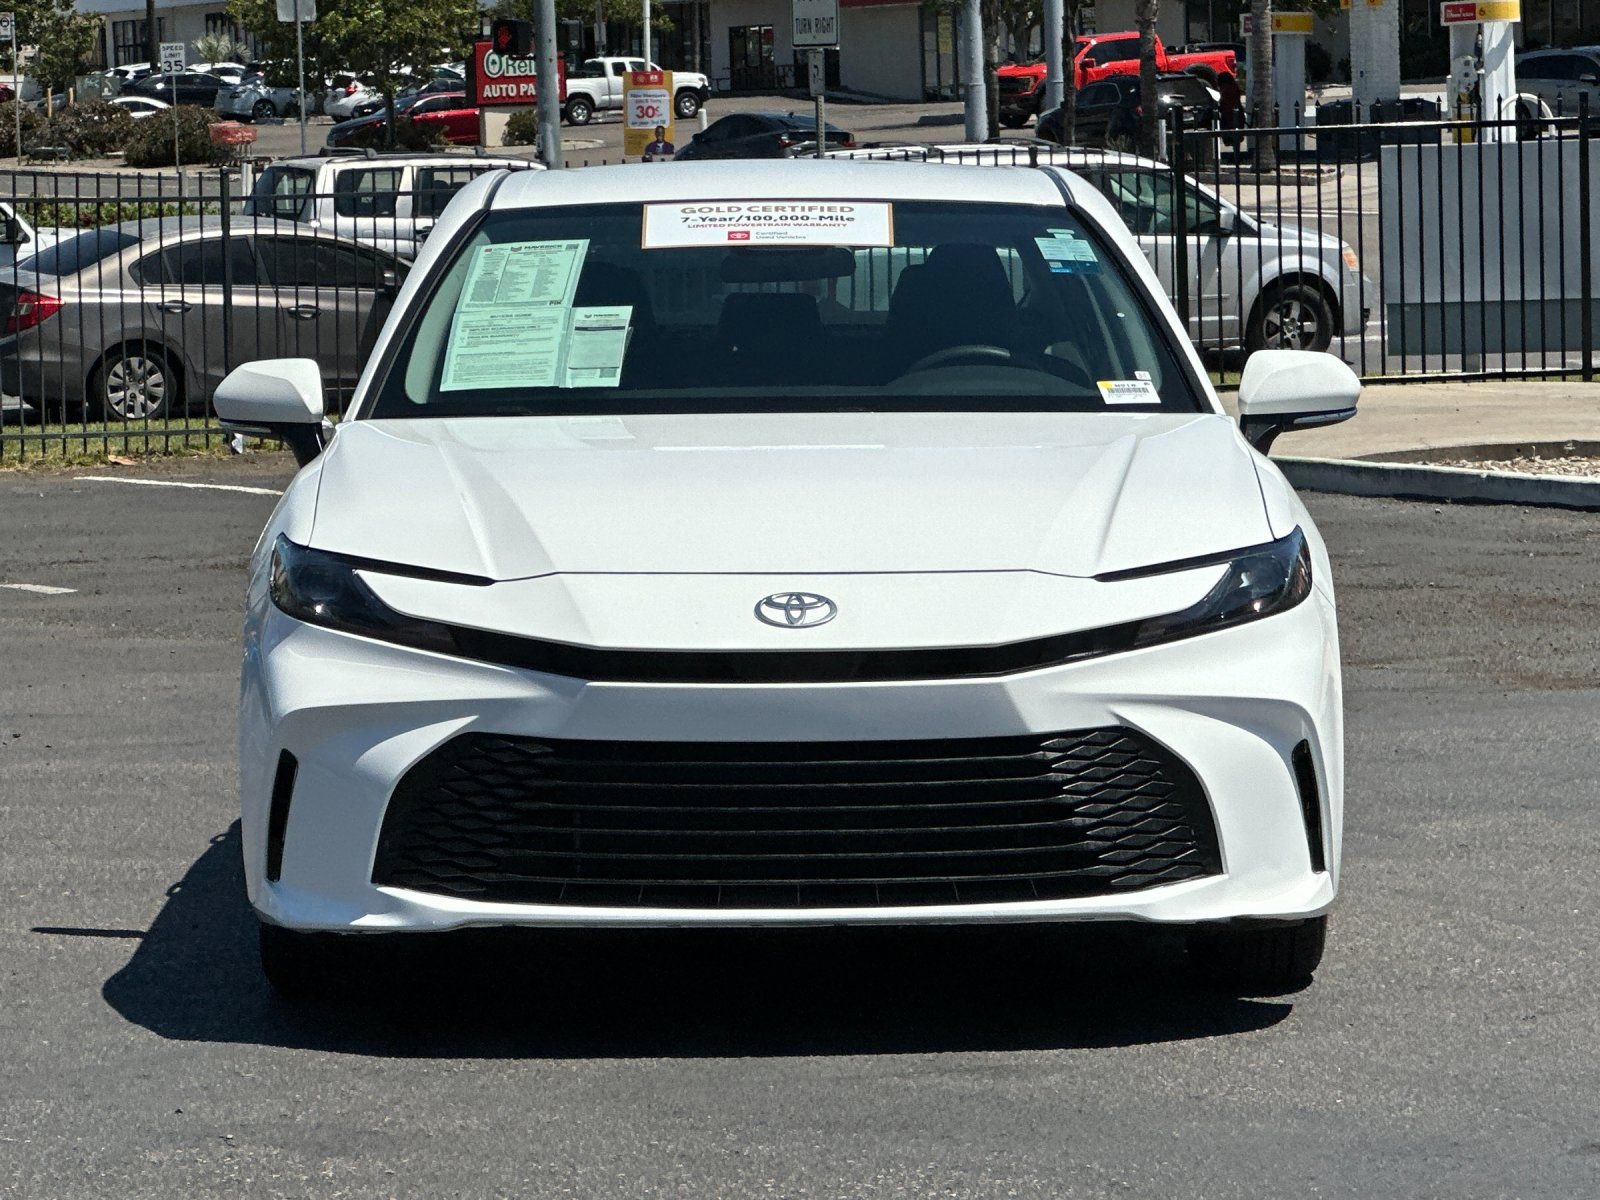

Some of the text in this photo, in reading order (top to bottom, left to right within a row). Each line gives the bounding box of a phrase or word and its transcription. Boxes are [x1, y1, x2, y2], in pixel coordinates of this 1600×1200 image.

[795, 17, 834, 34] TURN RIGHT
[163, 60, 184, 72] 35
[483, 84, 517, 98] AUTO
[680, 205, 855, 214] GOLD CERTIFIED
[680, 214, 856, 223] 7-Year/100,000-Mile
